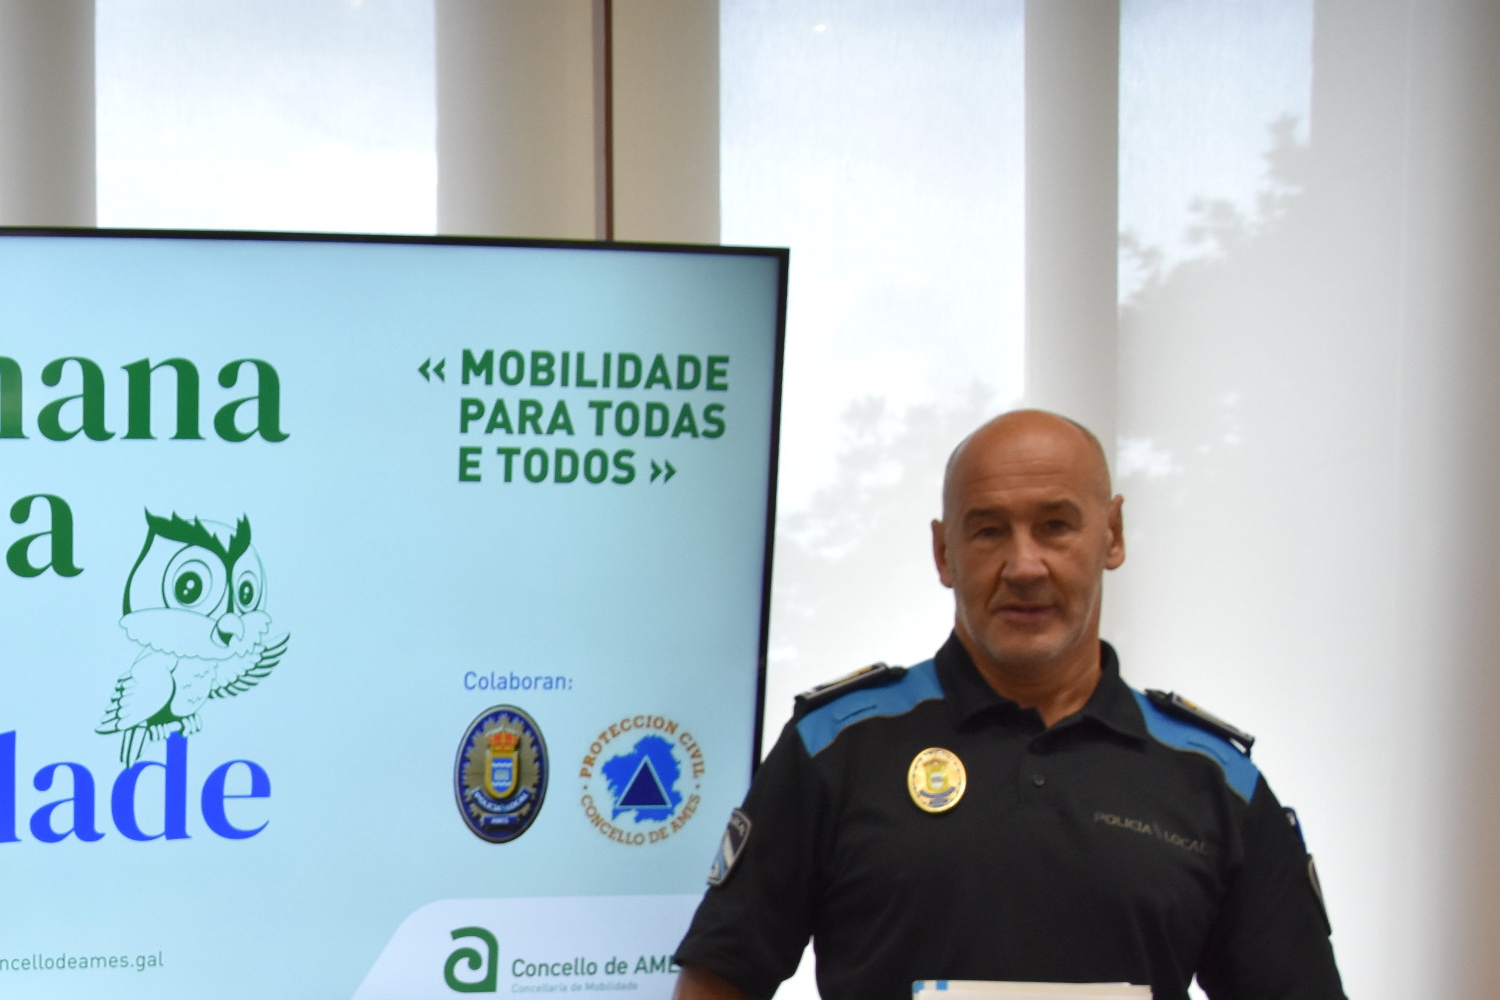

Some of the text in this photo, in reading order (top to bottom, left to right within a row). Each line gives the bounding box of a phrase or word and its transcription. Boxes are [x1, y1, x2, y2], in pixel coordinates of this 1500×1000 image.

[460, 349, 730, 392] MOBILIDADE
[459, 398, 727, 439] PARA TODAS
[458, 447, 483, 482] E
[496, 447, 637, 485] TODOS
[463, 671, 573, 690] Colaboran:
[678, 731, 706, 779] CIVIL
[580, 793, 645, 845] CONCELLO
[647, 829, 669, 845] DE
[669, 794, 701, 833] AMES
[511, 955, 682, 977] Concello de AME
[571, 982, 583, 992] de
[585, 981, 639, 992] Mobilidade
